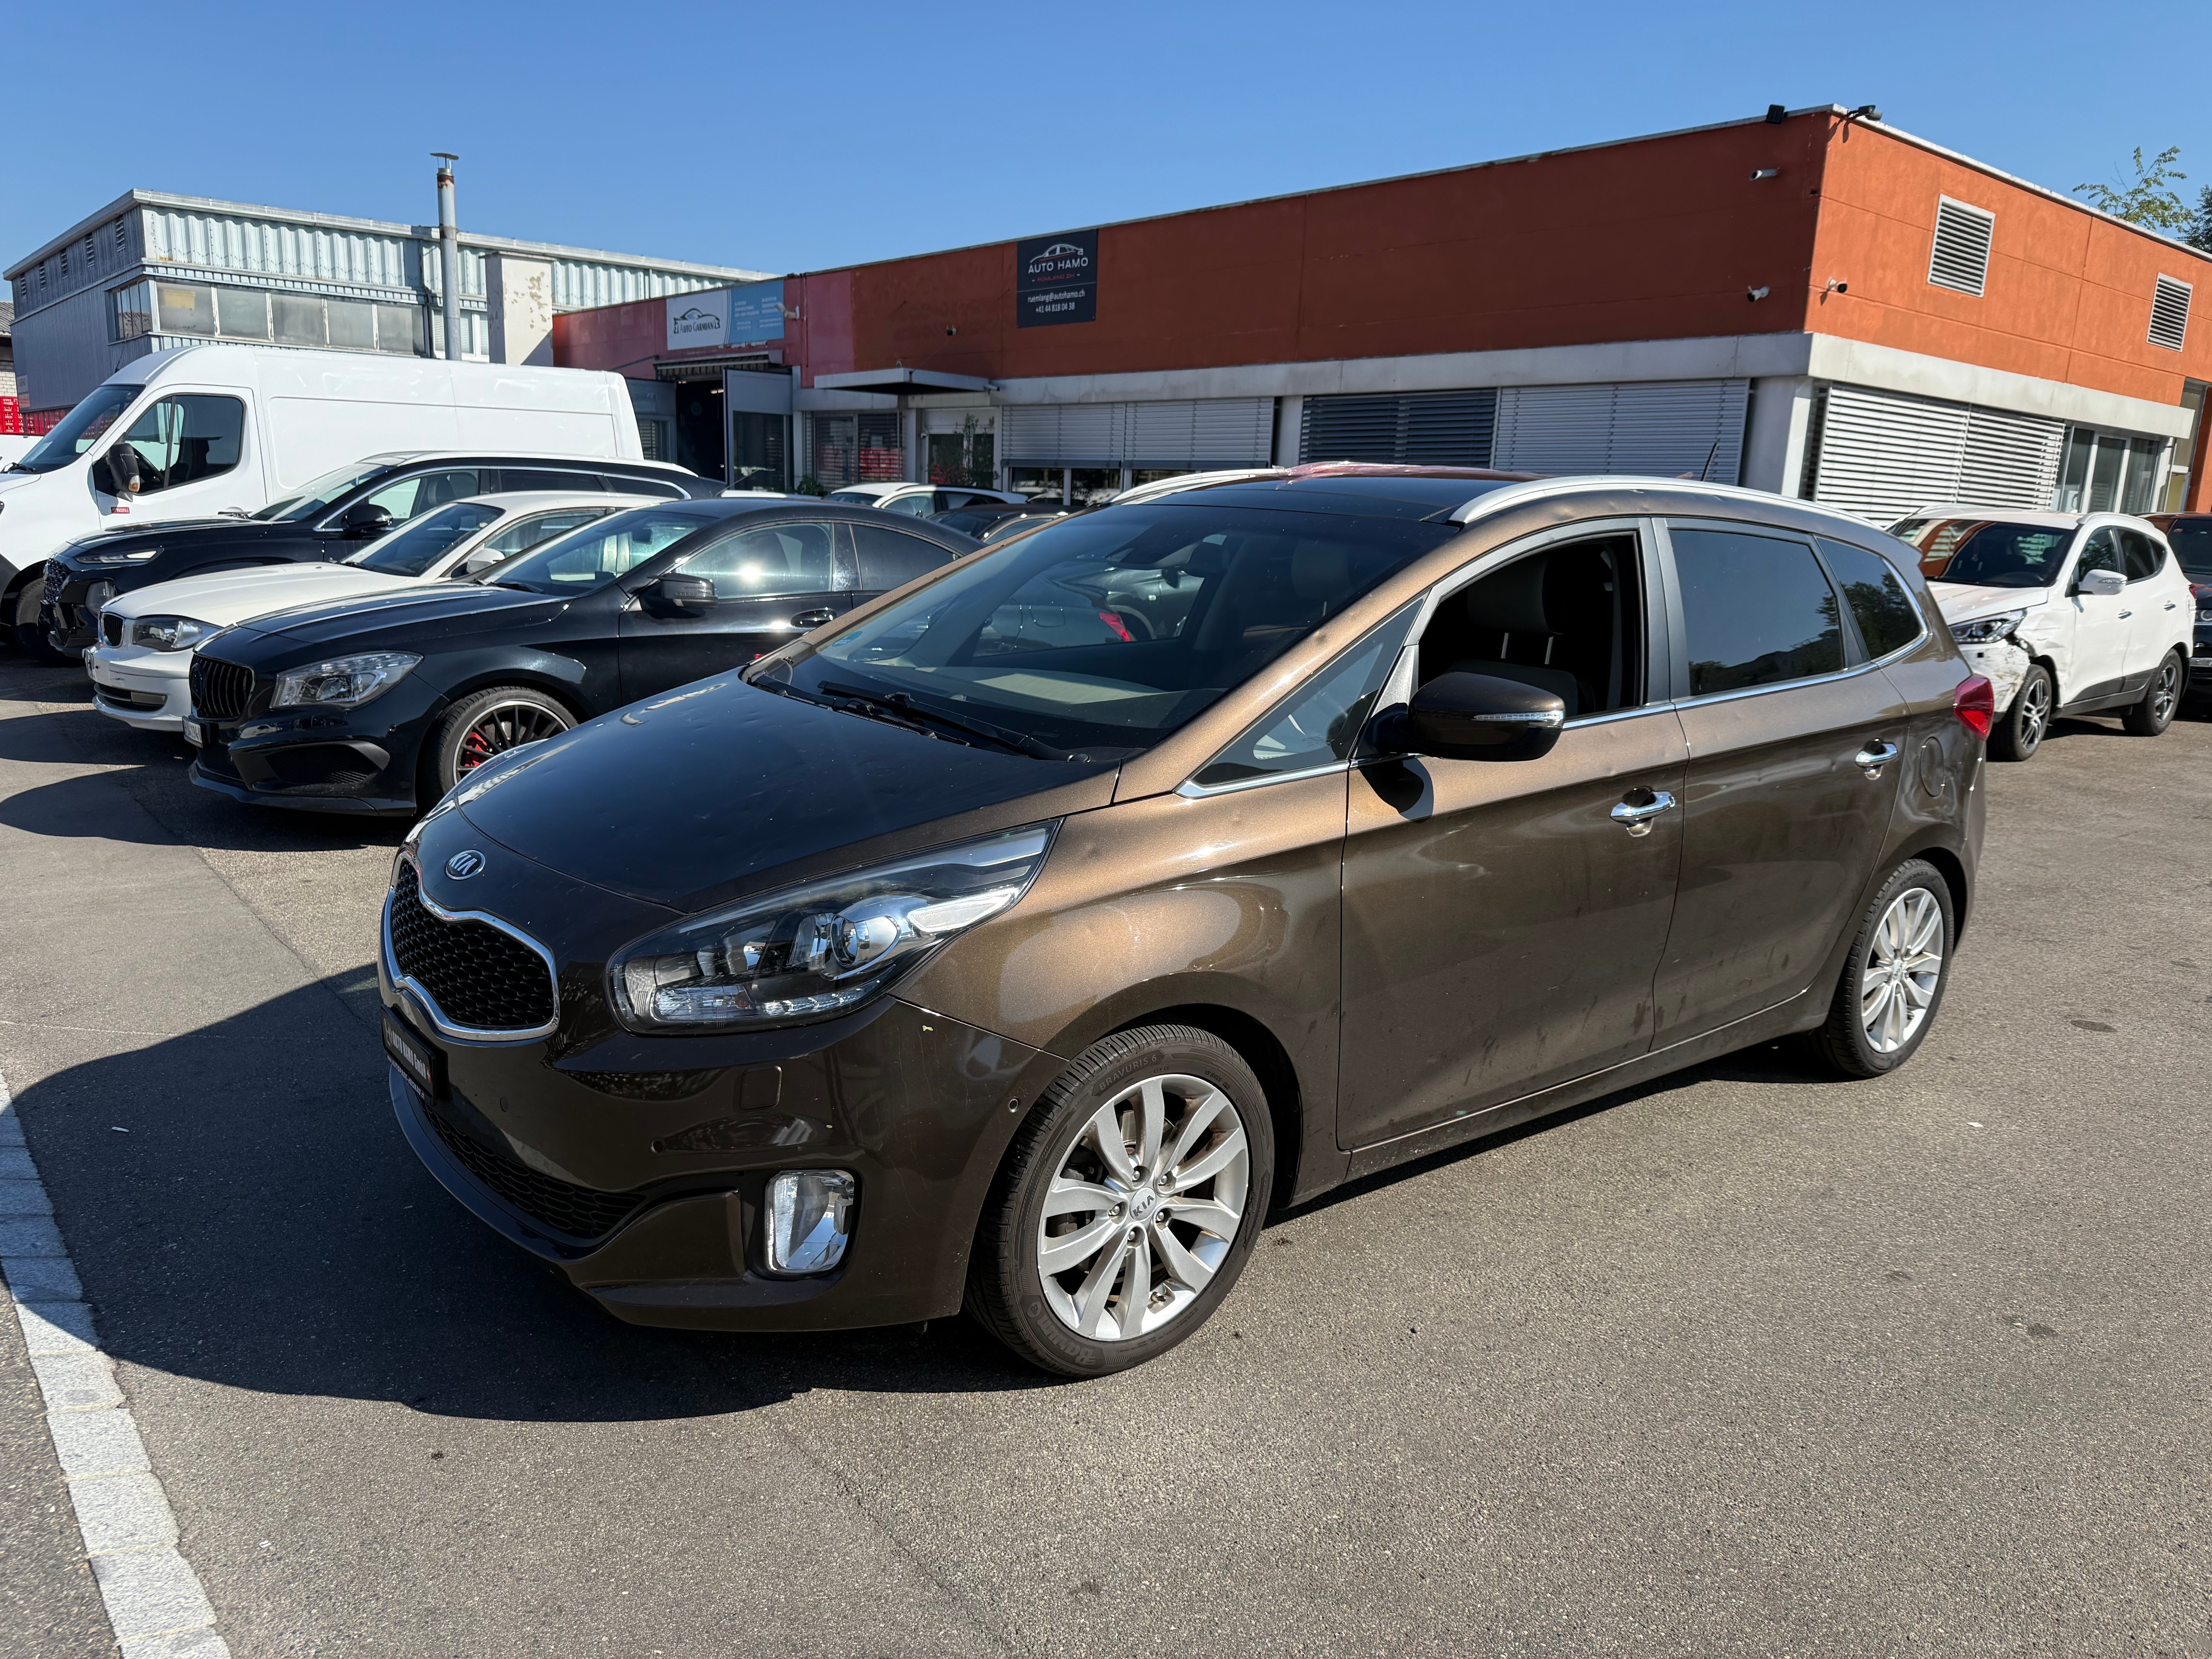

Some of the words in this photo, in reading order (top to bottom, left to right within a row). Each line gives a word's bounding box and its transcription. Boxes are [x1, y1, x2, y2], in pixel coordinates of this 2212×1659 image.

[1028, 262, 1054, 274] AUTO
[1057, 257, 1089, 270] HAMO
[1036, 304, 1044, 313] +41
[680, 324, 692, 333] AUTO
[693, 321, 714, 331] GARMIAN
[448, 853, 477, 875] KIA
[1099, 1057, 1148, 1091] BRAVURIS
[1133, 1195, 1154, 1217] KIA
[1037, 1315, 1096, 1365] Barum
